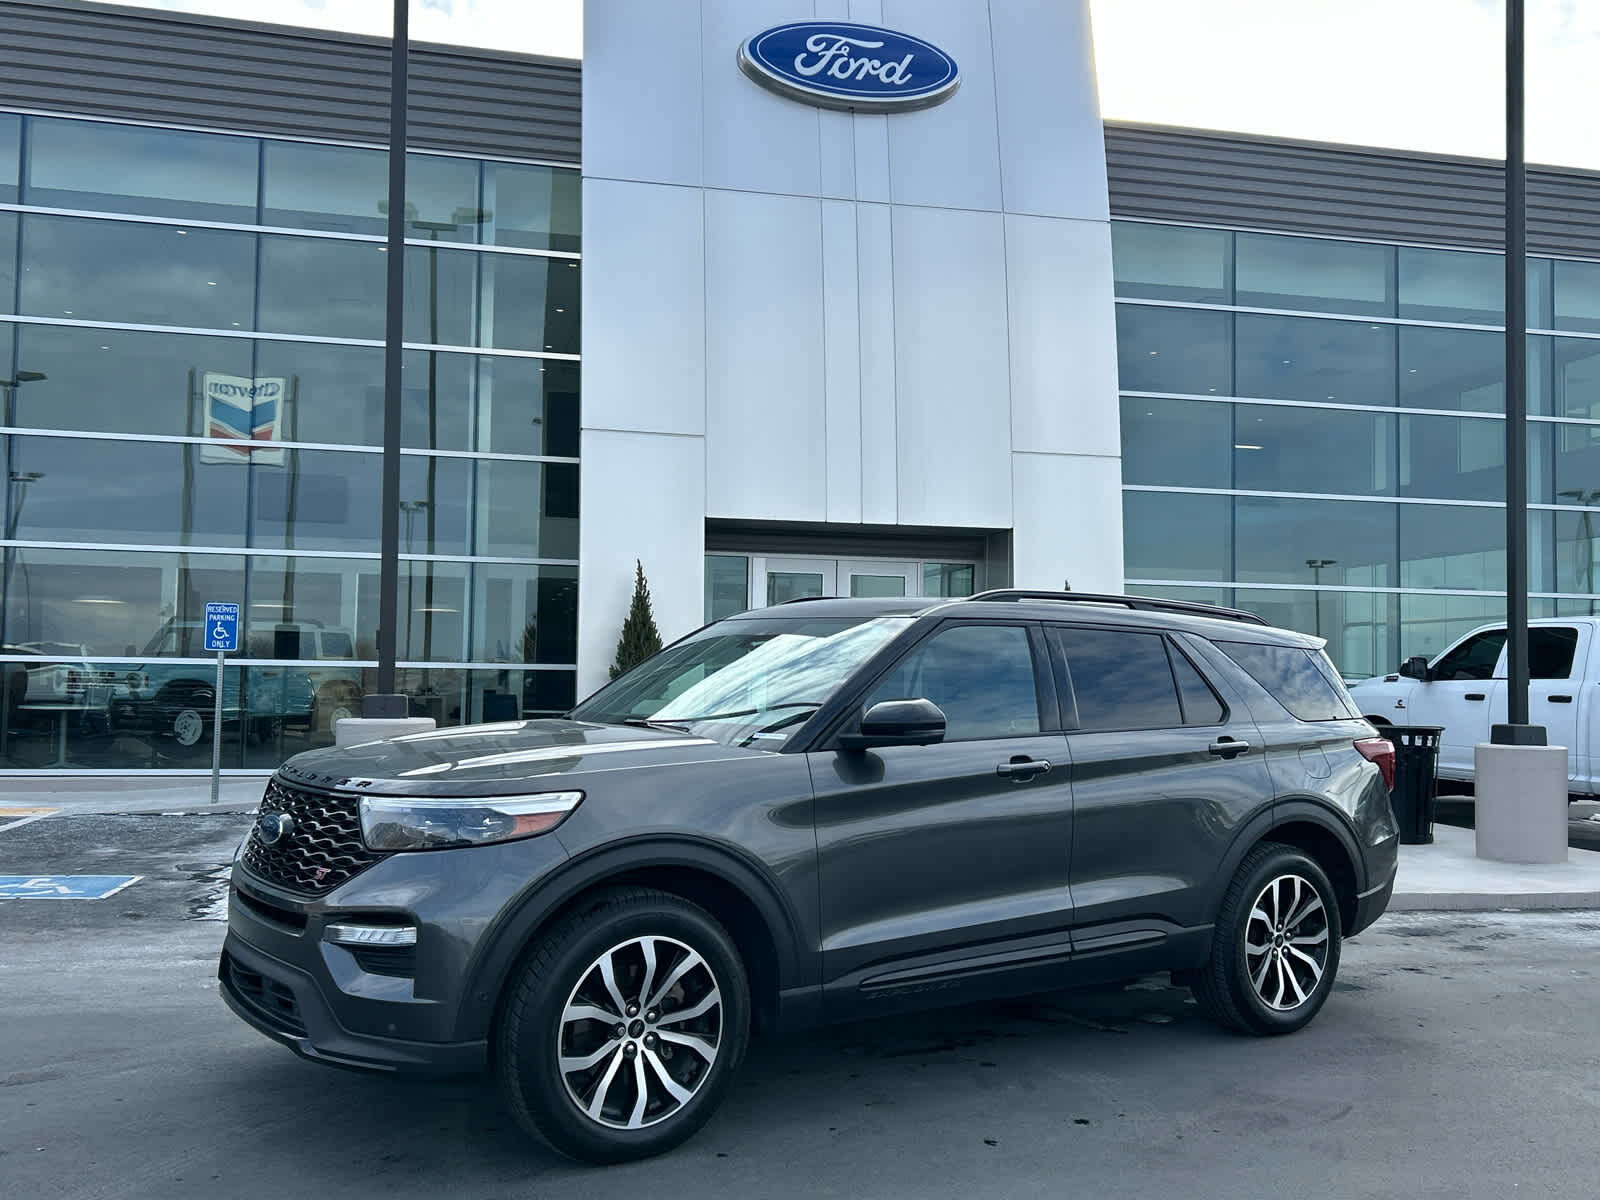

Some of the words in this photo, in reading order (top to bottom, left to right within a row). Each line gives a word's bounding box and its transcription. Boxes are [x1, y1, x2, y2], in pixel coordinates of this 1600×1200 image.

[794, 34, 914, 84] Ford
[207, 605, 238, 613] RESERVED
[211, 640, 231, 648] ONLY
